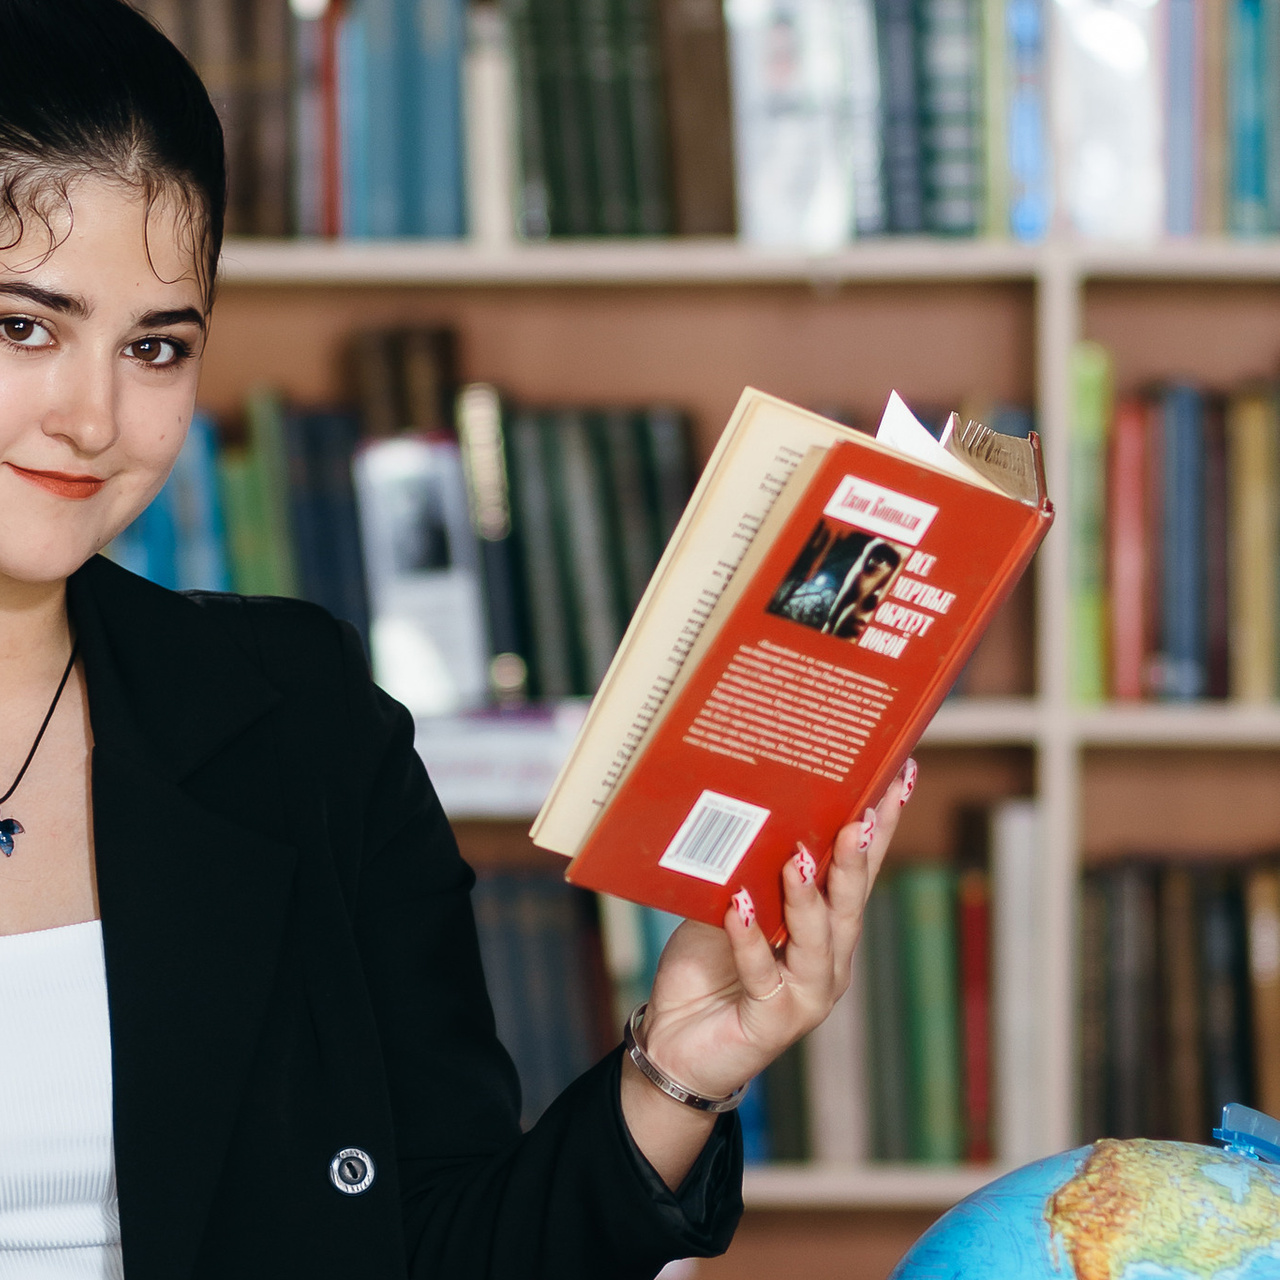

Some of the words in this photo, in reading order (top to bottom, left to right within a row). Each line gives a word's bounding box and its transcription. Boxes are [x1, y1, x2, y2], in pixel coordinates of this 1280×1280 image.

[905, 550, 937, 577] ВСЕ
[892, 575, 956, 615] МЕРТВЫЕ
[874, 600, 935, 638] ОБРЕТУТ
[858, 625, 909, 659] ПОКОЙ
